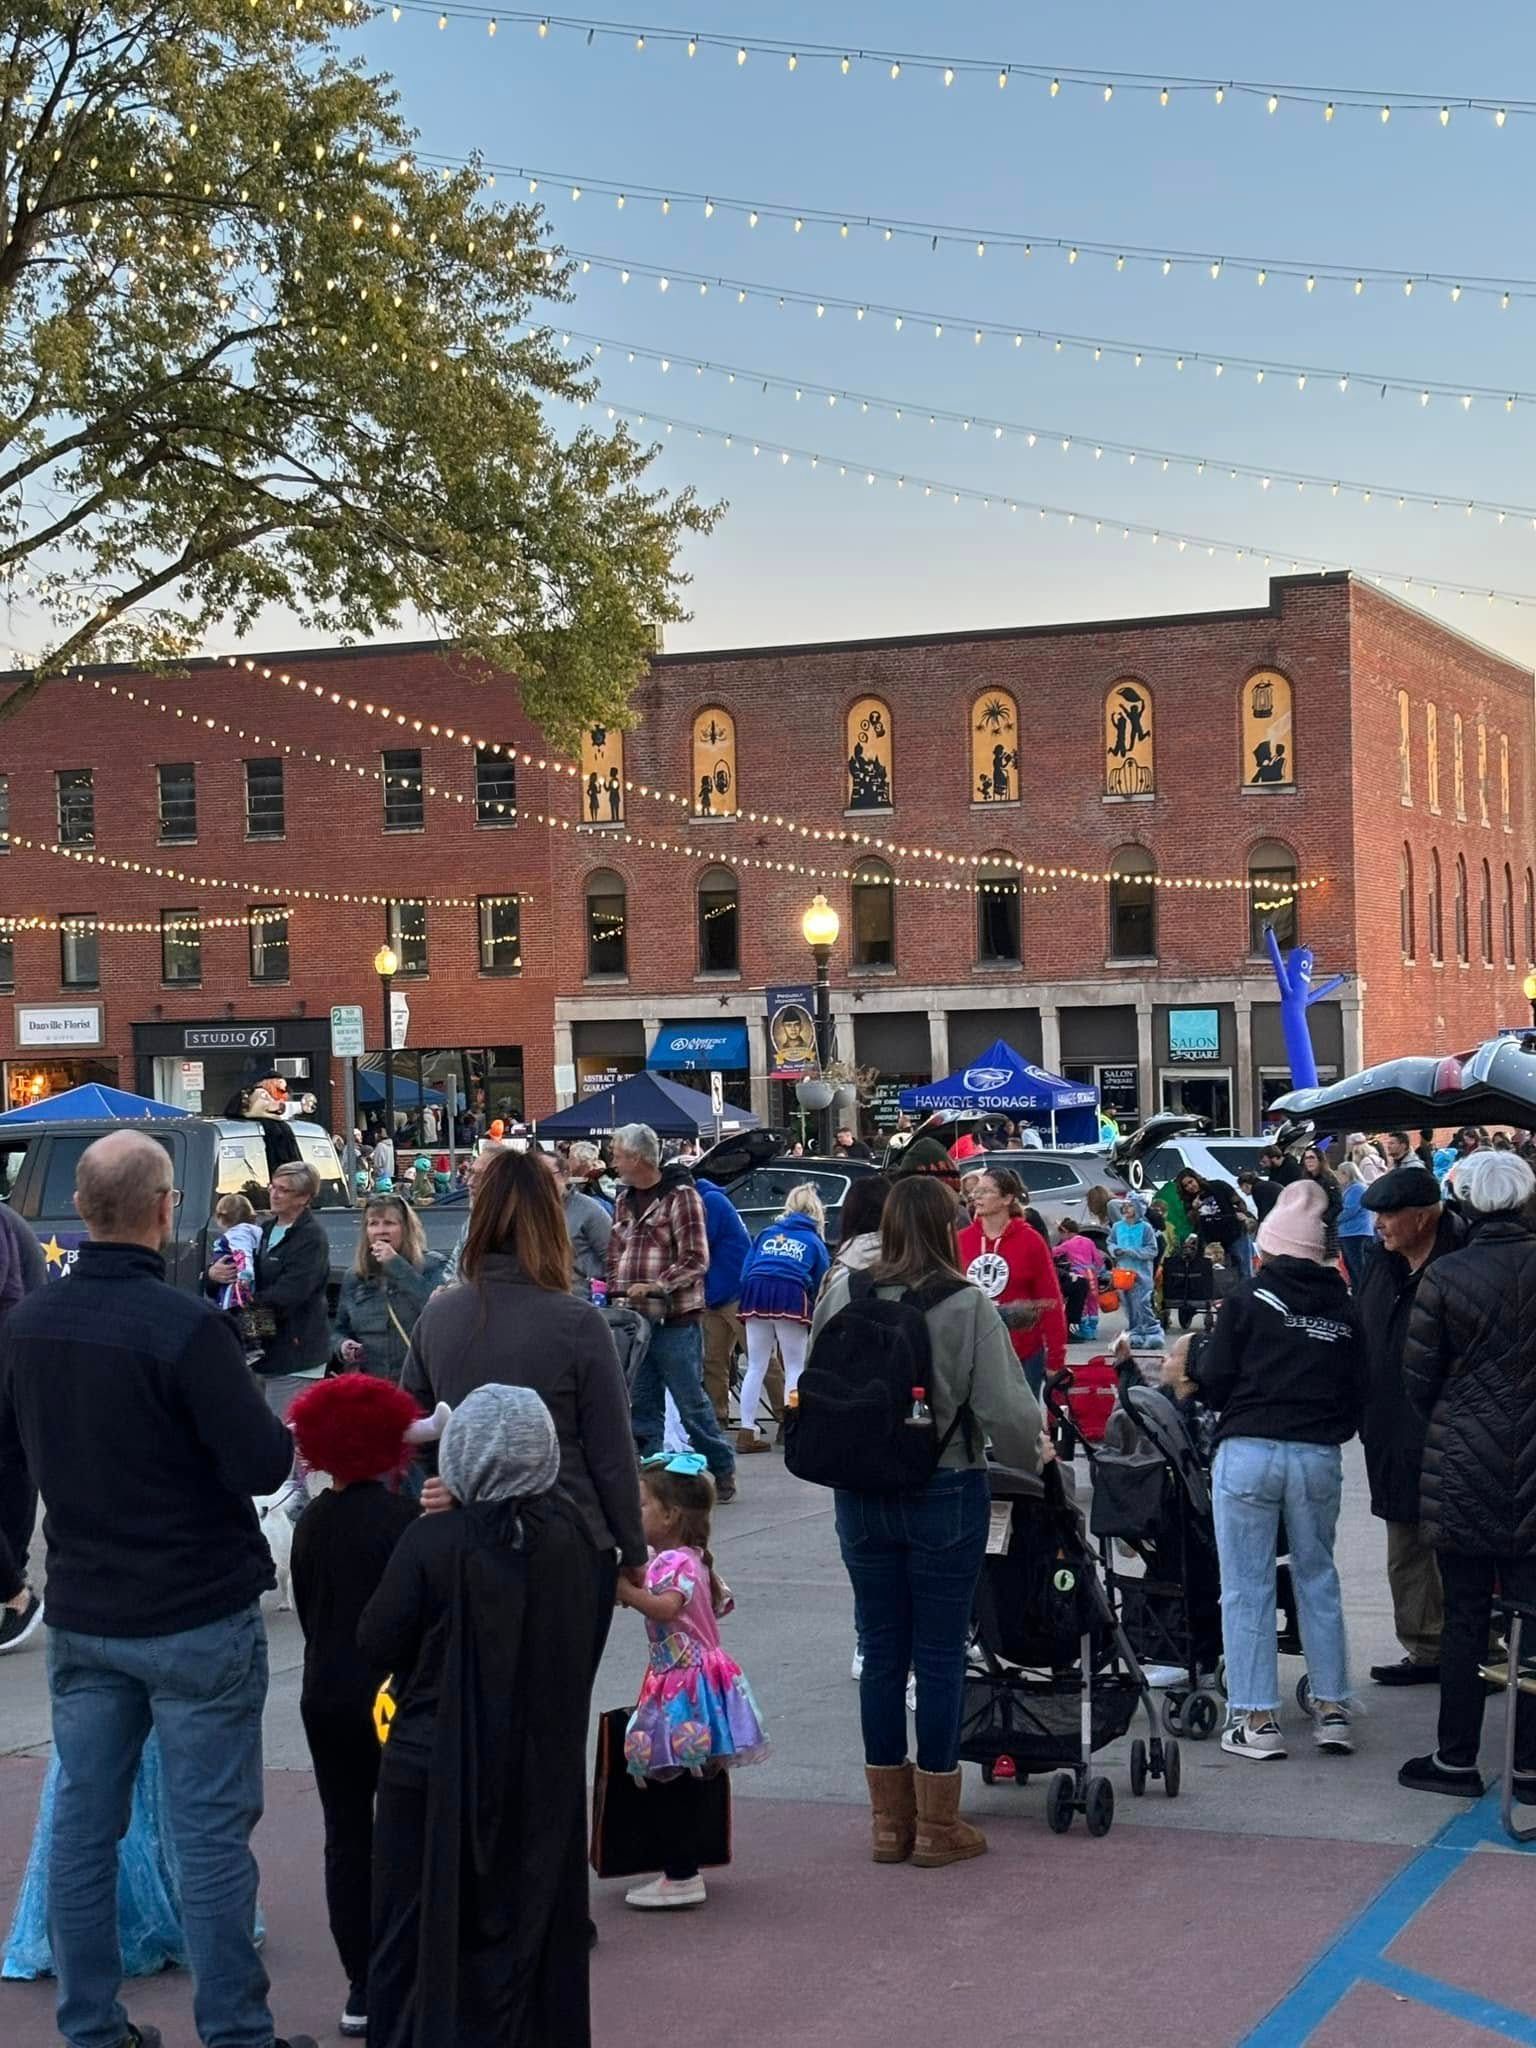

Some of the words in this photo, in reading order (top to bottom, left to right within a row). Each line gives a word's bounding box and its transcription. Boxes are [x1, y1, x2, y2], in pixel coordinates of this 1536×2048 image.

[333, 1010, 341, 1024] 2
[29, 1021, 62, 1030] Danville
[64, 1020, 90, 1029] Florist
[193, 1033, 246, 1044] STUDIO
[250, 1030, 268, 1047] 65
[690, 1037, 727, 1045] Abstract
[1171, 1037, 1217, 1049] SALON
[1184, 1050, 1220, 1061] SQUARE
[684, 1061, 695, 1069] 71
[583, 1074, 615, 1082] ABSTRACT
[1104, 1070, 1134, 1078] SALON
[915, 1095, 973, 1108] HAWKEYE
[978, 1095, 1037, 1108] STORAGE
[763, 1239, 808, 1262] CLARK
